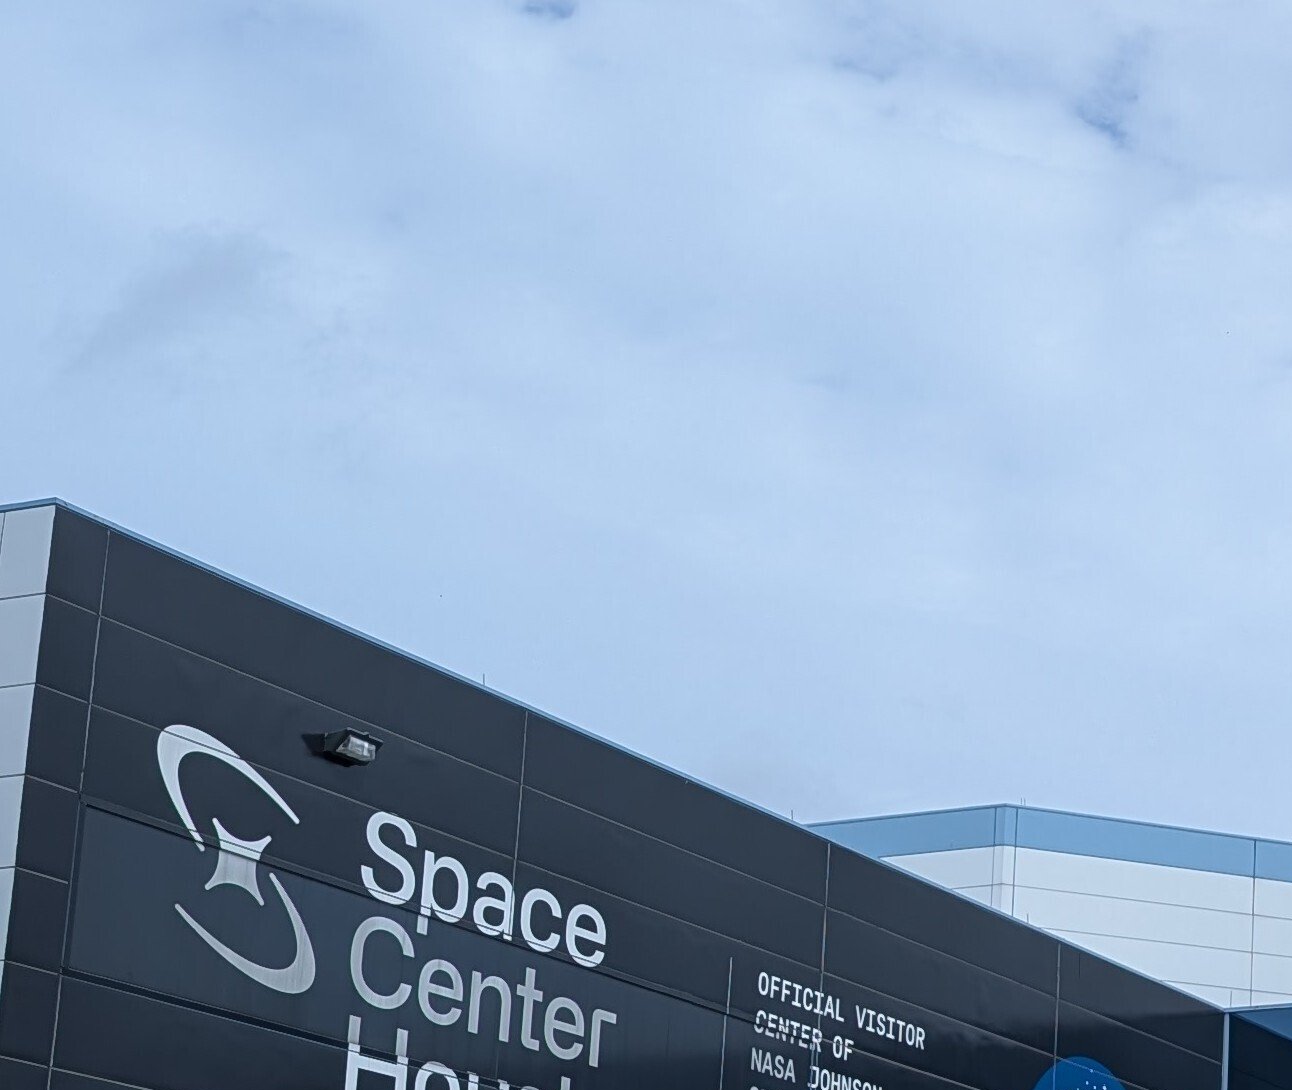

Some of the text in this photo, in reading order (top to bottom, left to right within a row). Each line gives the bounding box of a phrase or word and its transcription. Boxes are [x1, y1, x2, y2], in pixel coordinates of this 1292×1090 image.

[360, 811, 607, 968] Space
[350, 916, 617, 1068] Center
[758, 971, 926, 1050] OFFICIAL VISITOR
[750, 1047, 796, 1084] NASA
[753, 1009, 855, 1061] CENTER OF
